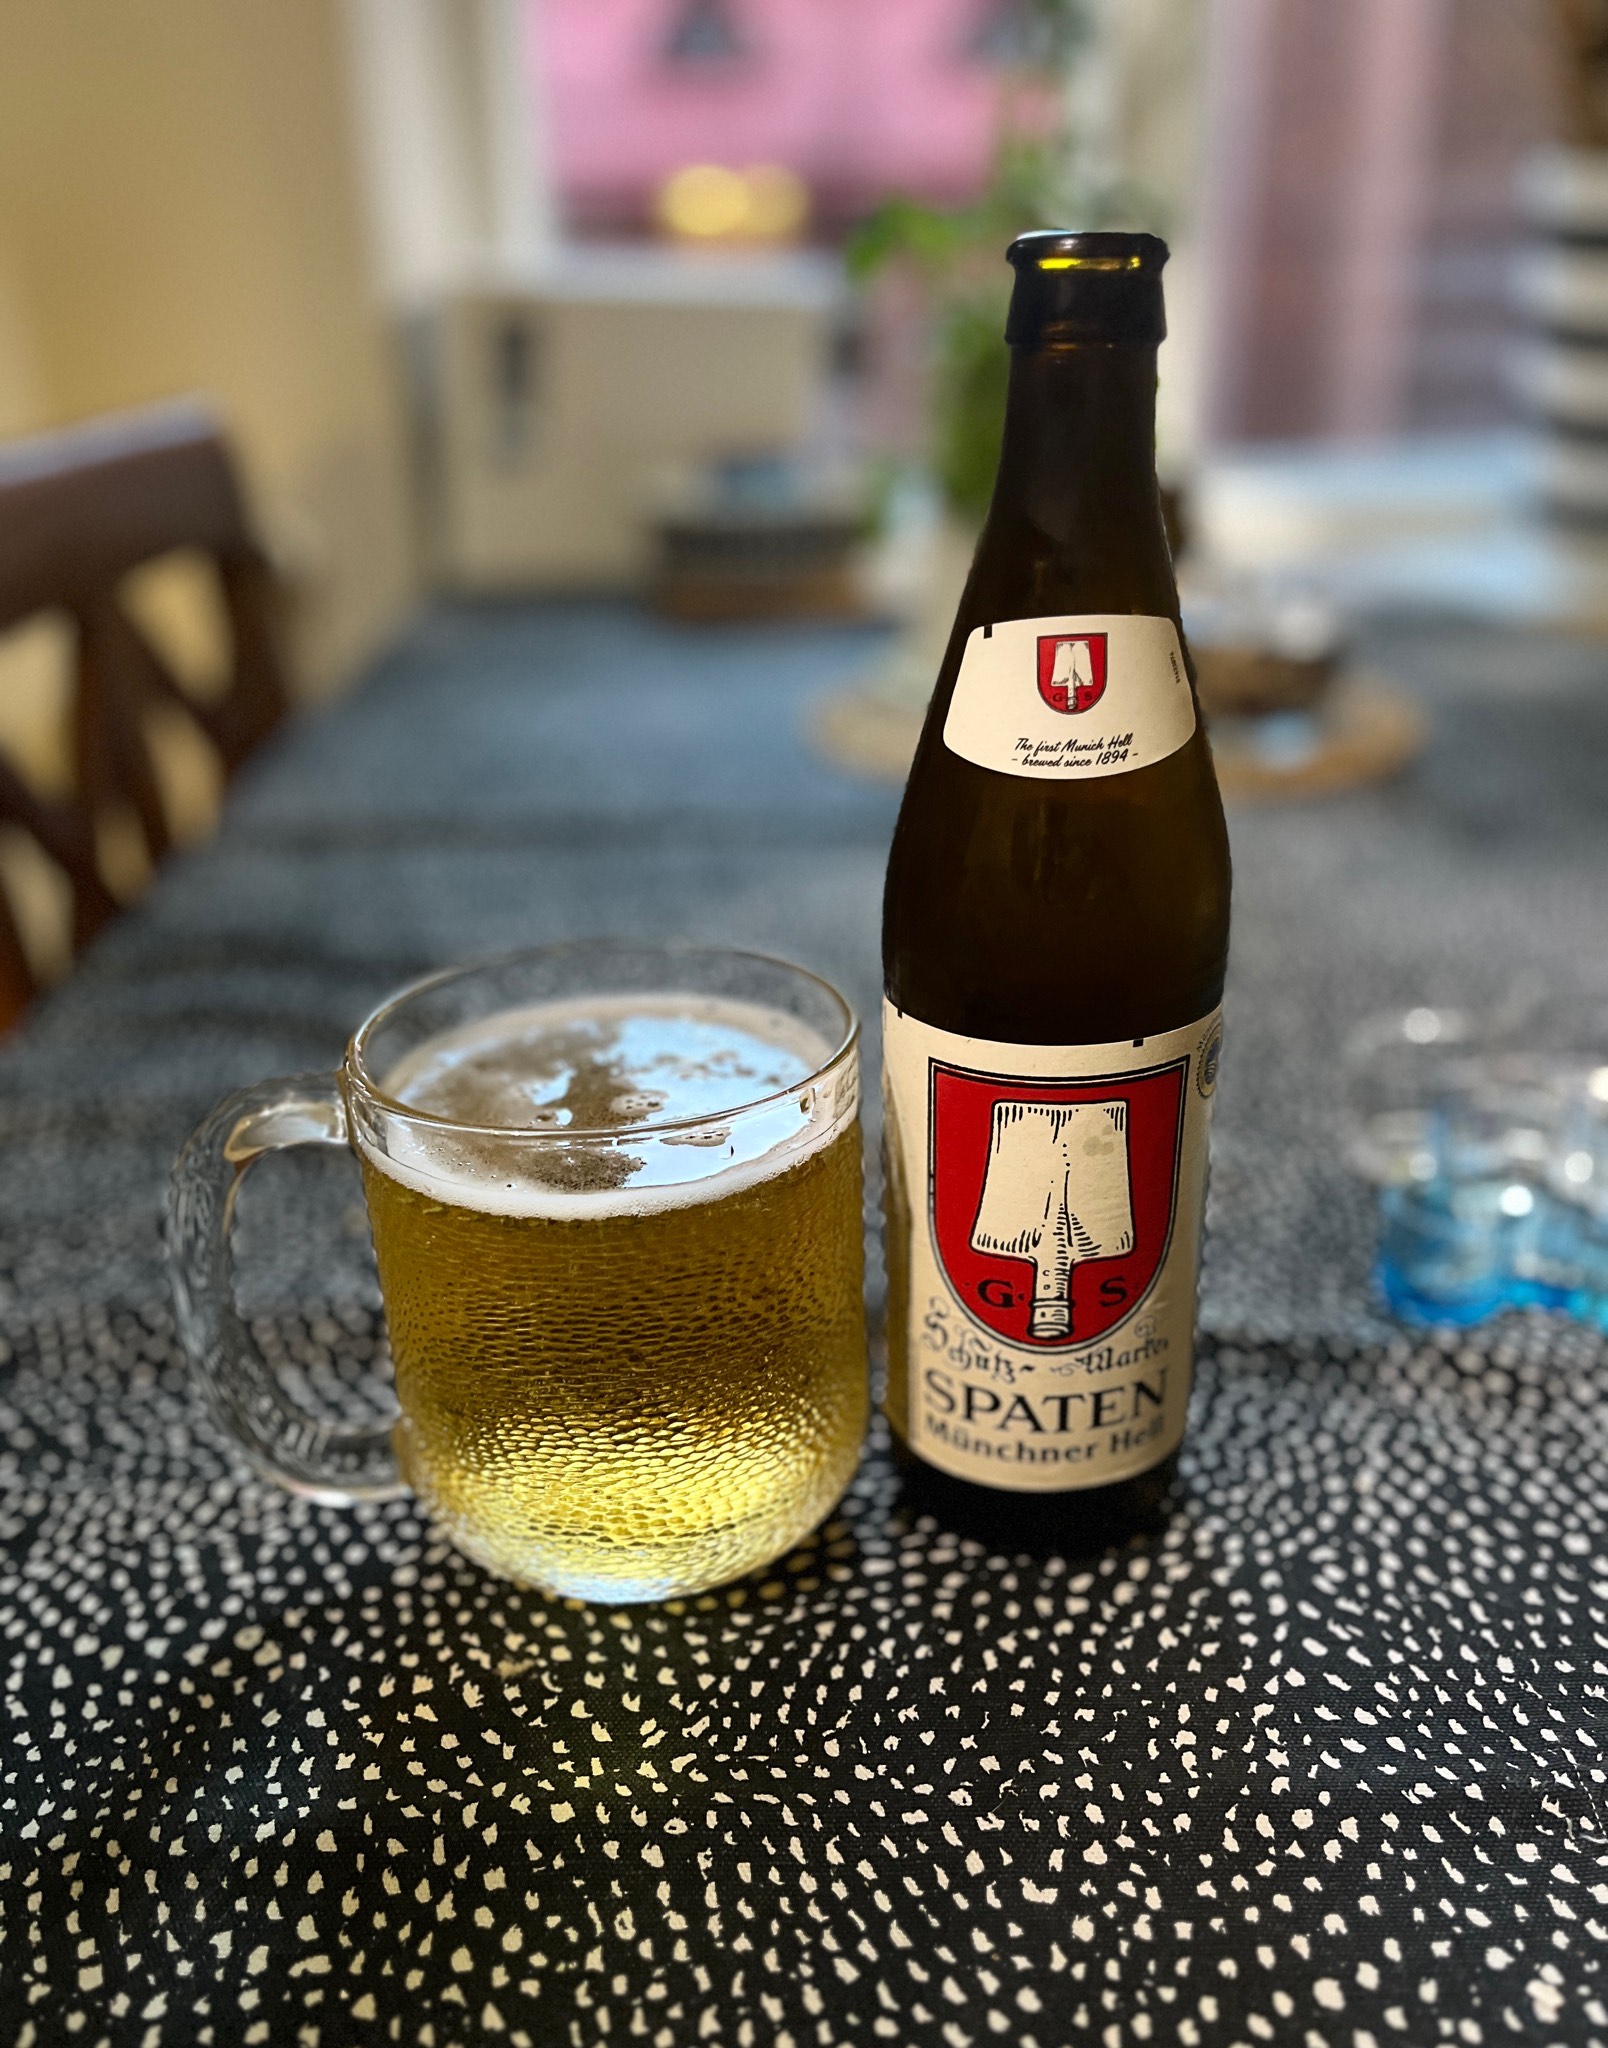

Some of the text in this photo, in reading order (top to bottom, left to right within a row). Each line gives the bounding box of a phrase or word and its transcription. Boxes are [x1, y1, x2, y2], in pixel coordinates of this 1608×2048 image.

[1015, 732, 1133, 757] The first Munich Hell
[1022, 748, 1128, 767] brewed since 1894
[1101, 1276, 1128, 1306] S
[925, 1367, 1167, 1434] SPATEN
[926, 1413, 1098, 1464] Münchner
